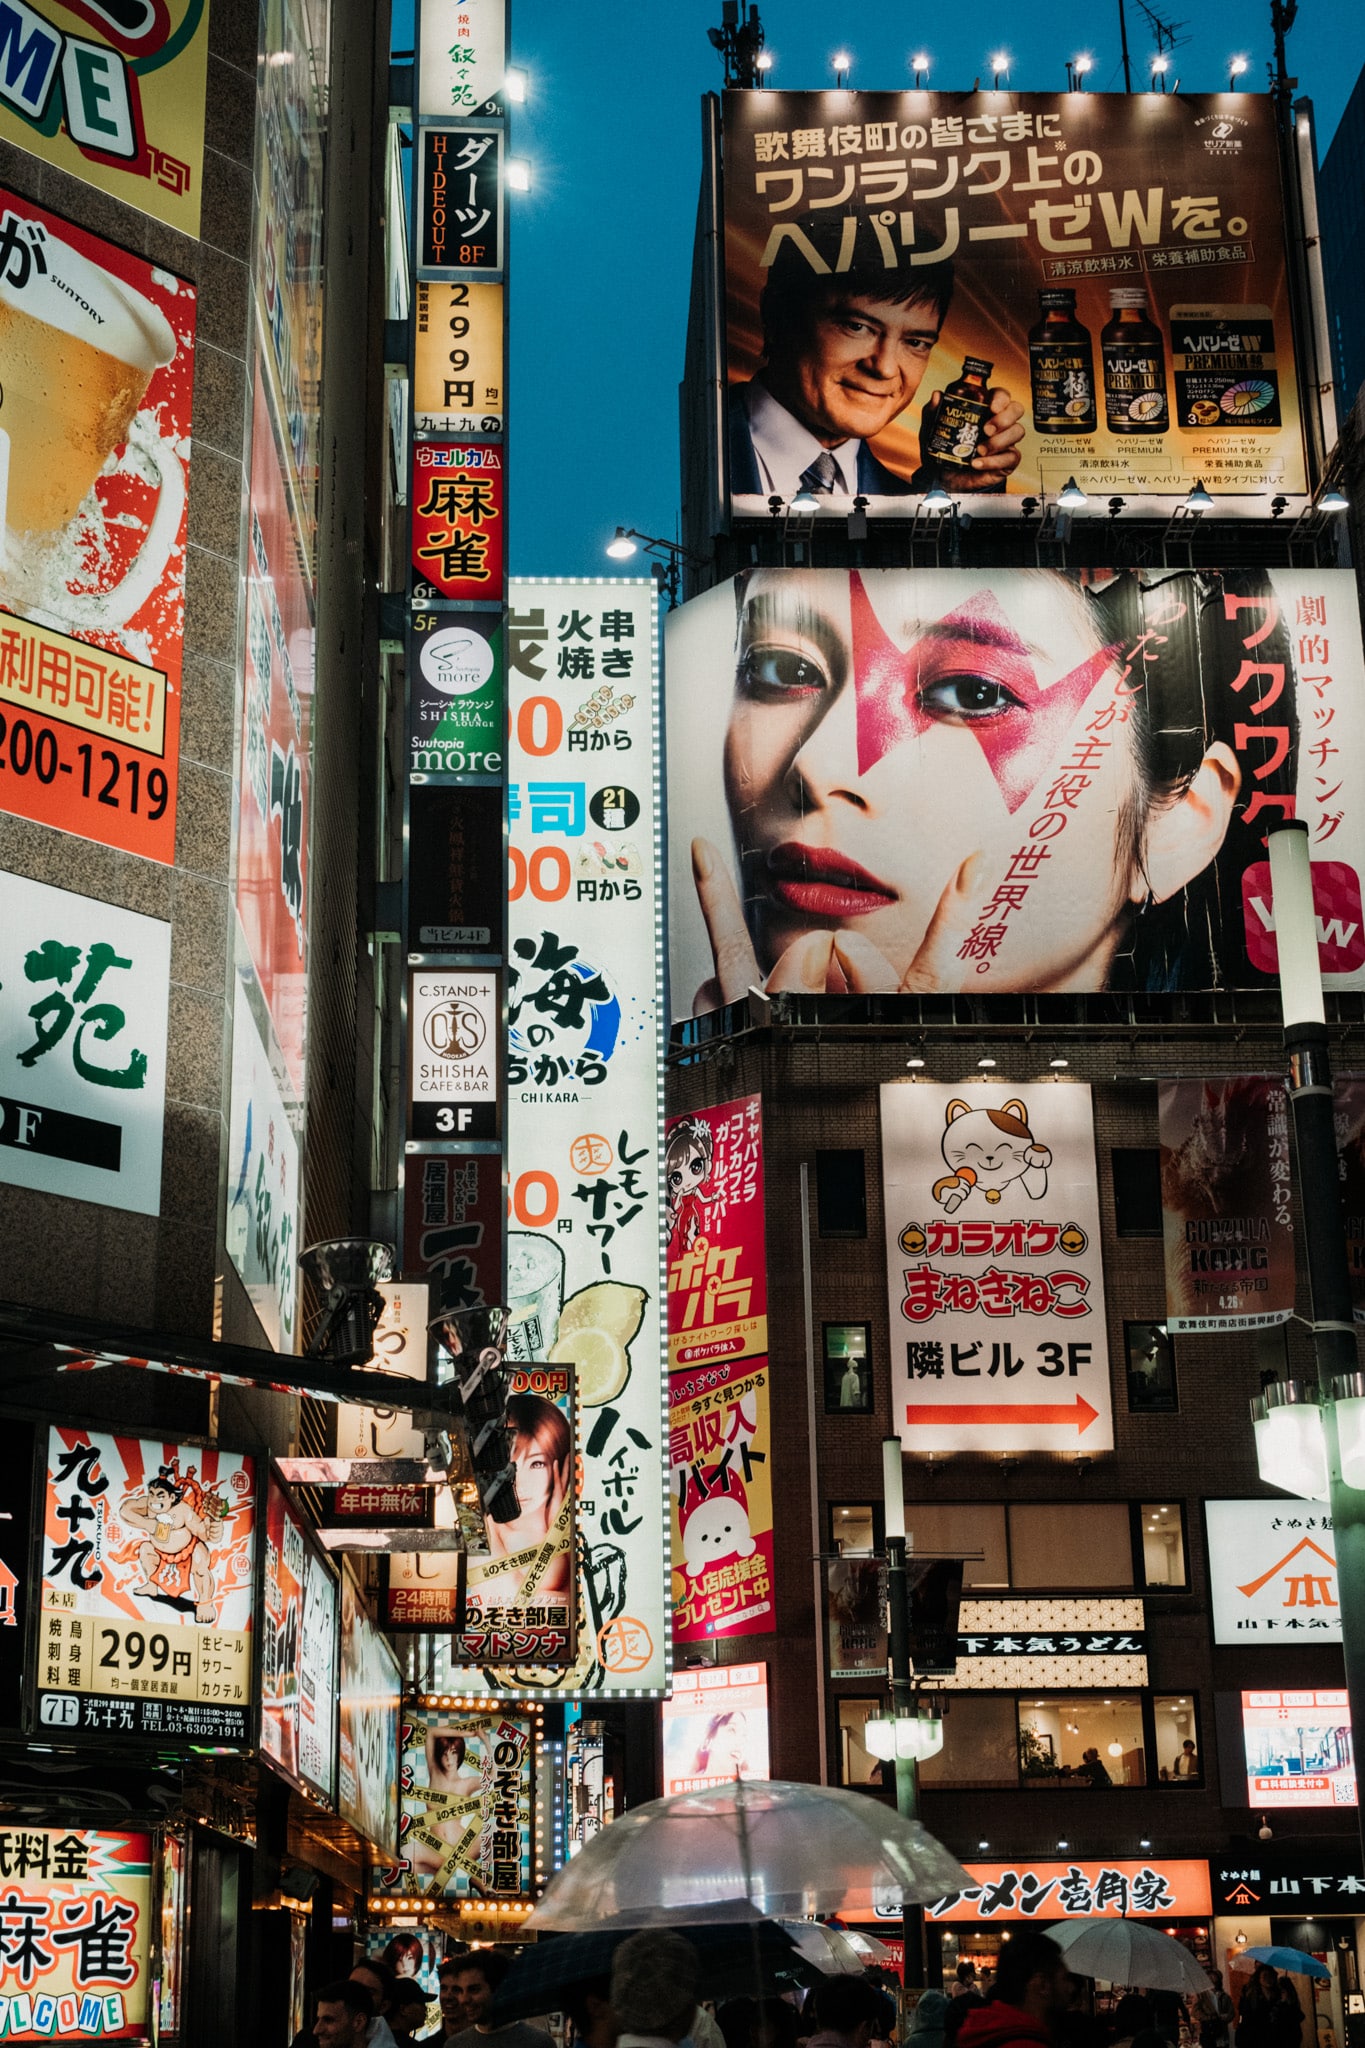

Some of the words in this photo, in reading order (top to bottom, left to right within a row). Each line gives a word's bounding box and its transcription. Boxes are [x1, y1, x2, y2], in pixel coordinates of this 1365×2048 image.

[458, 14, 470, 37] 焼肉
[485, 101, 503, 116] 9F
[754, 111, 1062, 163] 歌舞伎町の皆さまに
[454, 136, 494, 238] ダーツ
[432, 136, 447, 263] HIDEOUT
[759, 187, 1249, 275] ヘパリーゼWを。
[459, 245, 485, 264] 8F
[1050, 256, 1135, 276] 清涼飲料水
[1152, 245, 1247, 267] 栄養補助食品
[443, 283, 475, 408] 299円
[421, 416, 475, 432] 九十九
[483, 420, 499, 431] 7F
[417, 447, 501, 469] ウェルカム
[1040, 446, 1085, 454] PREMIUM
[1117, 446, 1163, 454] PREMIUM
[1192, 446, 1238, 454] PREMIUM
[1080, 459, 1130, 469] 清涼飲料水
[1205, 459, 1263, 469] 栄養補助食品
[418, 473, 499, 581] 麻雀
[413, 582, 437, 599] 6F
[413, 614, 437, 631] 5F
[437, 673, 480, 683] more
[420, 711, 482, 721] SHISHA
[1296, 595, 1345, 844] 劇的マッチング
[411, 736, 464, 751] Suutopia
[411, 751, 501, 772] more
[956, 593, 1188, 975] わたしが主役の世界線。
[16, 940, 147, 1090] 苑
[420, 1065, 488, 1078] SHISHA
[521, 1092, 579, 1103] CHIKARA
[0, 1104, 42, 1146] F
[435, 1108, 473, 1131] 3F
[729, 1112, 744, 1205] コンカフェ
[743, 1101, 760, 1203] キャバクラ
[1266, 1090, 1294, 1232] 常識が変わる。
[712, 1120, 731, 1234] ガールズバー
[926, 1221, 1060, 1257] カラオケ
[1185, 1217, 1272, 1243] GODZILLA
[1191, 1247, 1269, 1272] KONG
[903, 1264, 1092, 1323] まねきねこ
[906, 1341, 1025, 1379] 隣ビル
[1037, 1342, 1093, 1376] 3F
[691, 1373, 766, 1416] 今すぐ見つかる
[670, 1400, 757, 1470] 高収入
[585, 1406, 653, 1536] ハイボール
[678, 1440, 766, 1509] バイト
[341, 1493, 419, 1512] 年中無休
[43, 1441, 110, 1591] 九十九
[95, 1500, 104, 1561] TSUKUMO
[48, 1592, 75, 1608] 本店
[396, 1591, 450, 1607] 24時間
[675, 1576, 771, 1630] プレゼント中
[391, 1607, 454, 1623] 年中無休
[467, 1605, 568, 1627] のぞき部屋
[202, 1636, 244, 1654] 生ビール
[463, 1632, 566, 1657] マドンナ
[957, 1636, 1143, 1654] 下本気うどん
[202, 1659, 232, 1674] サワー
[201, 1681, 243, 1699] カクテル
[45, 1698, 78, 1722] 7F
[84, 1707, 134, 1729] 九十九
[501, 1726, 525, 1748] 元祖
[493, 1742, 521, 1892] のぞき部屋
[0, 1997, 120, 2029] LCOME
